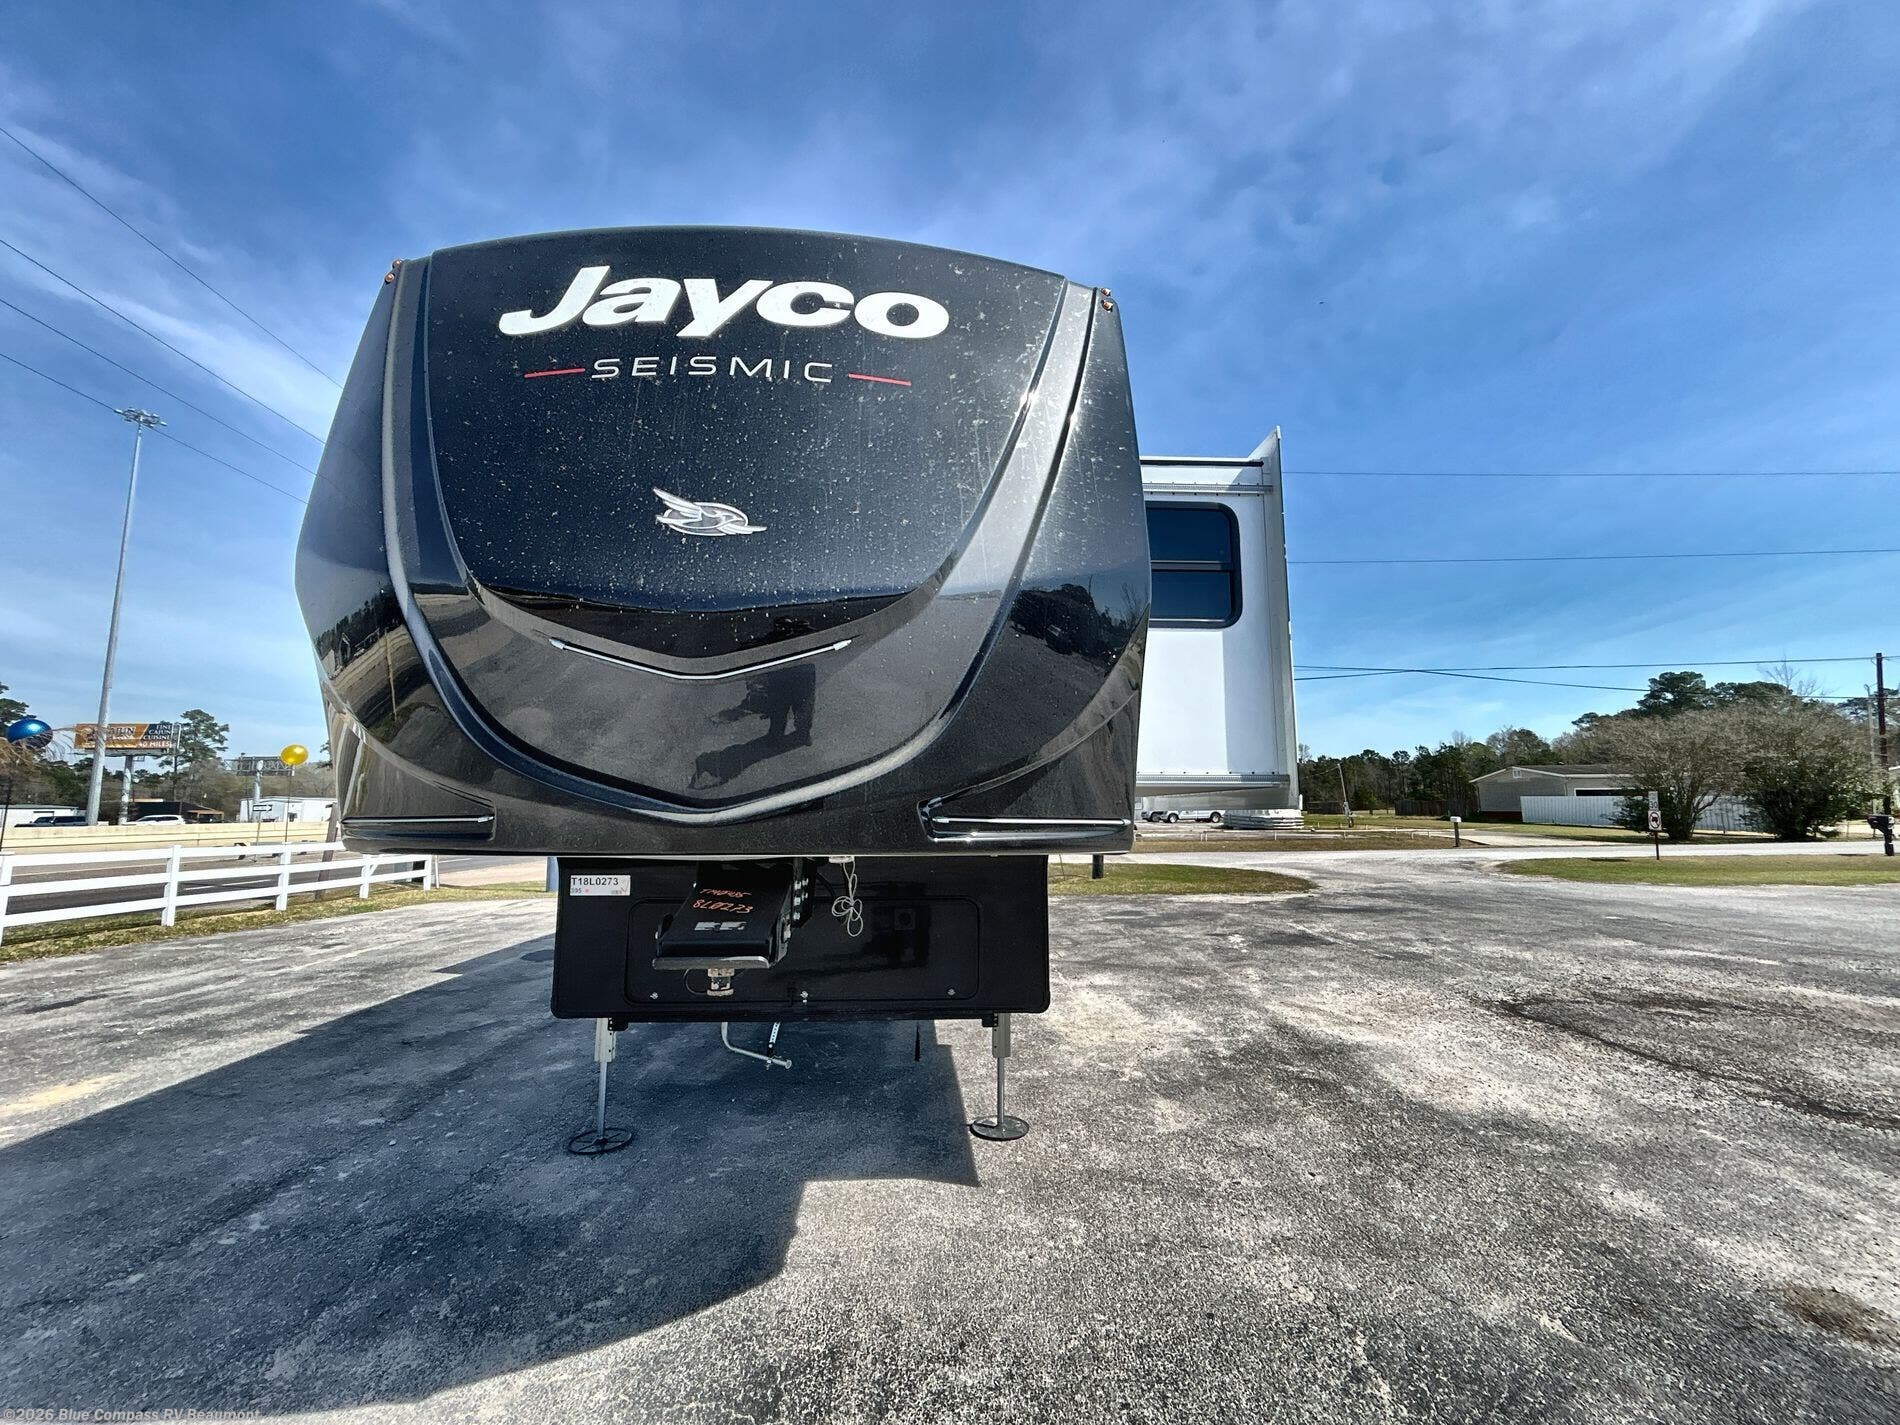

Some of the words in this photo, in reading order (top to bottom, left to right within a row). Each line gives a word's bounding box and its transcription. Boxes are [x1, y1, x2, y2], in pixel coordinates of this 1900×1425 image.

[498, 265, 950, 340] Jayco
[591, 355, 834, 383] SEISMIC
[571, 877, 619, 886] T18L0273
